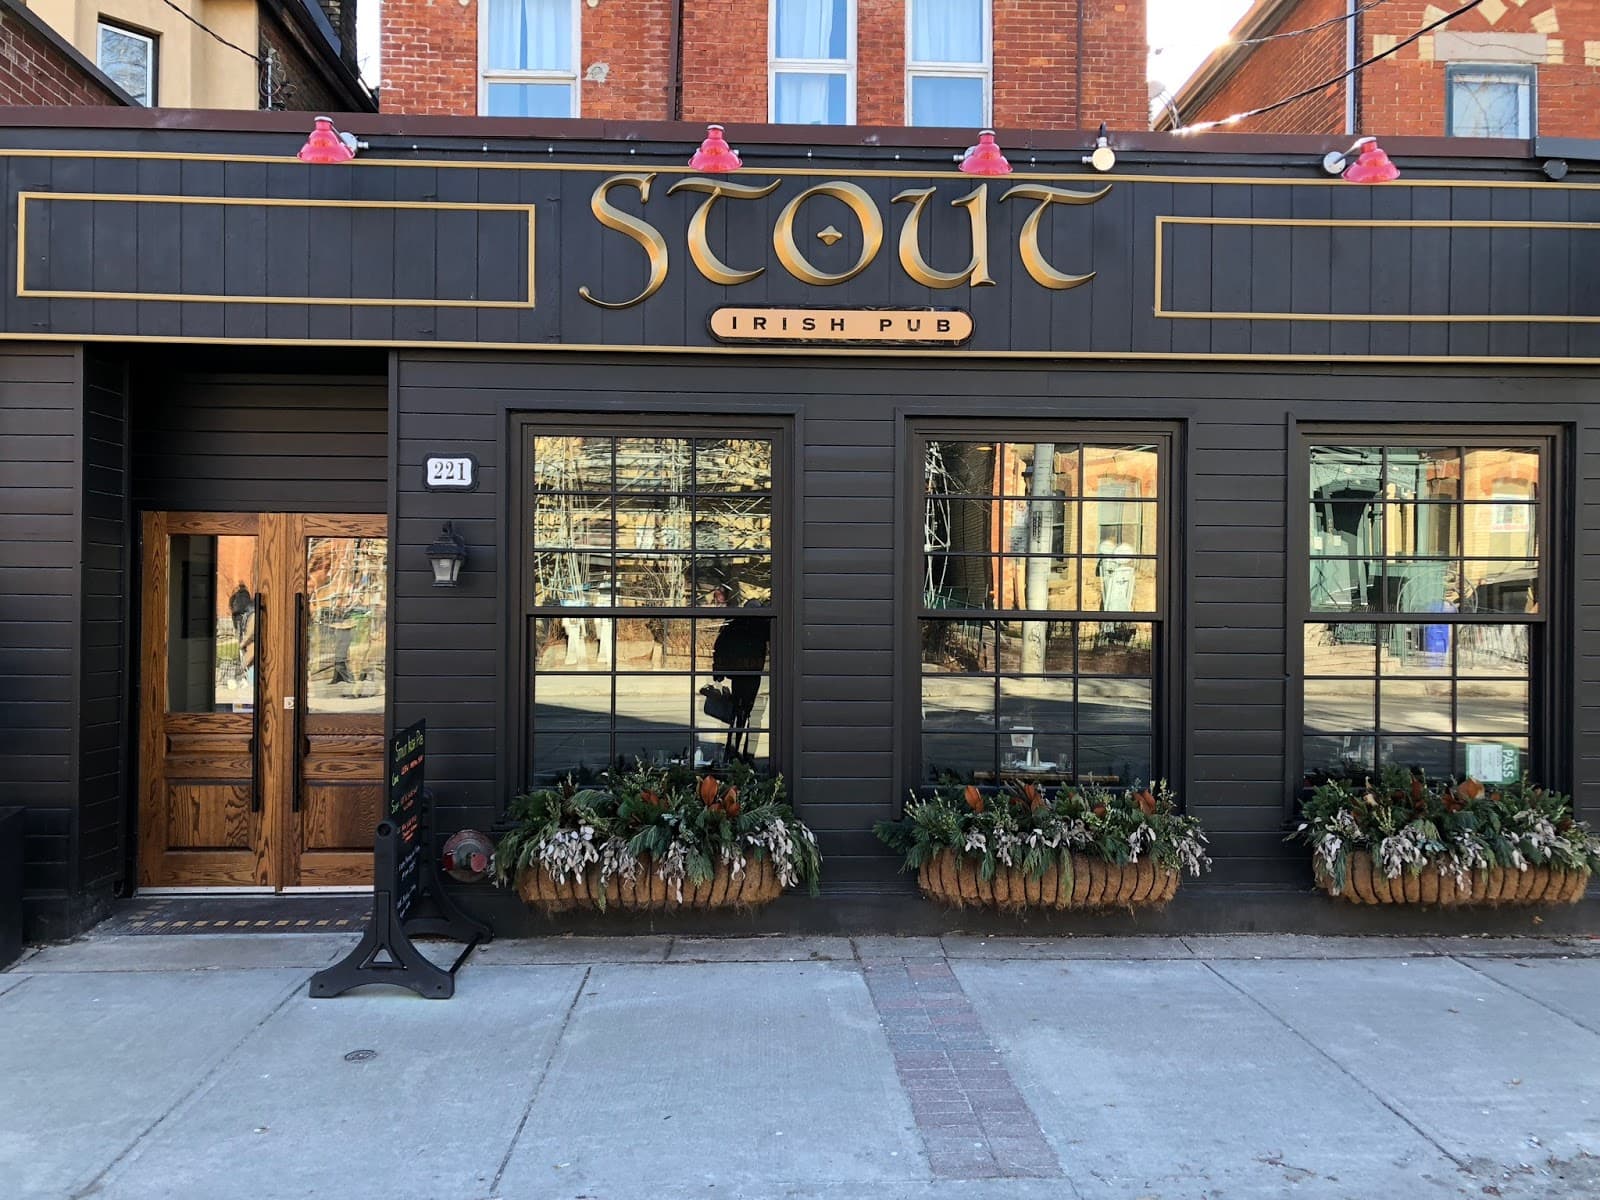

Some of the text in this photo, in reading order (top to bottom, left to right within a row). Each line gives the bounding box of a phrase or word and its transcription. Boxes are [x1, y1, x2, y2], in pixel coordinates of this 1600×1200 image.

[732, 316, 952, 333] IRISH PUB
[434, 461, 466, 480] 221
[1502, 749, 1514, 778] PASS
